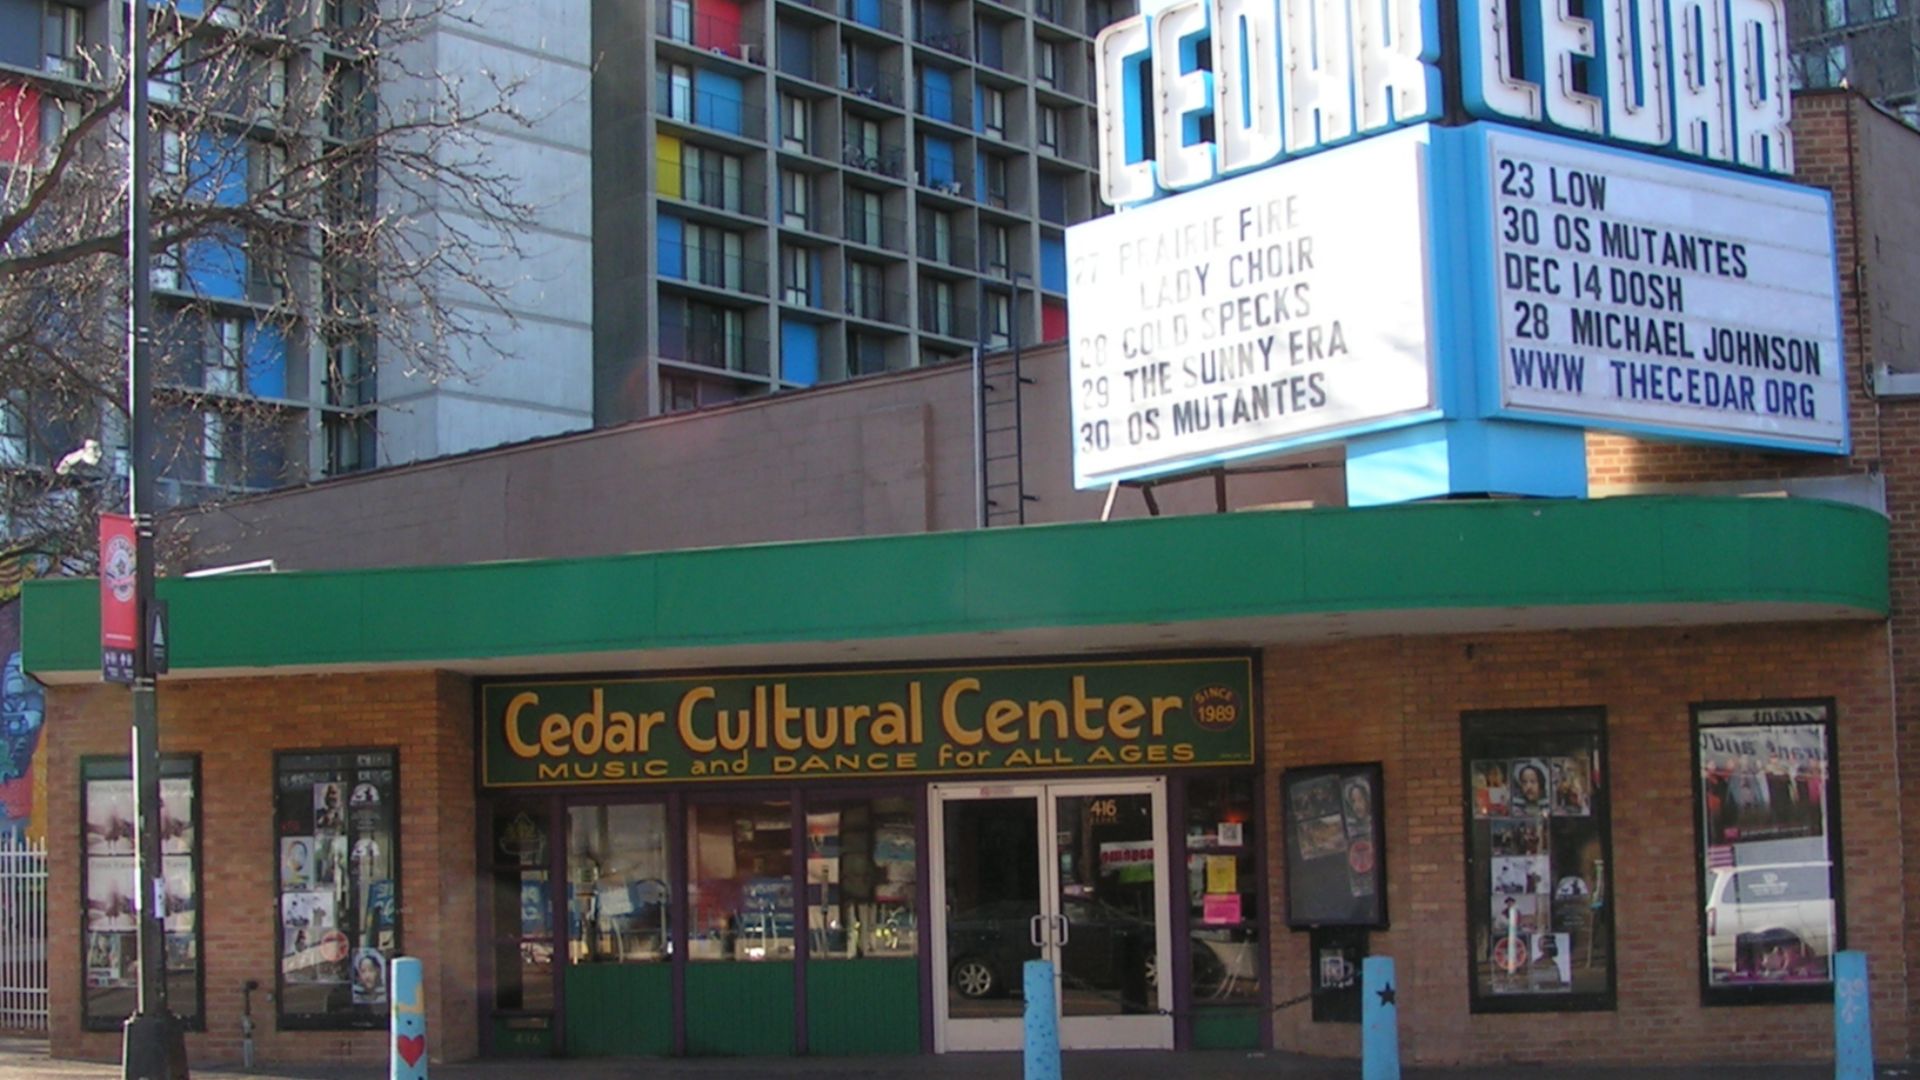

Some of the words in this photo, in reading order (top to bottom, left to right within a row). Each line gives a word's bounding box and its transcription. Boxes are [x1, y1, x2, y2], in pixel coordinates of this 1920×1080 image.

[1095, 0, 1430, 205] CEDAR
[1480, 0, 1796, 177] CEDAR
[1239, 195, 1299, 242] FIRE
[1500, 159, 1535, 199] 23
[1550, 166, 1606, 211] LOW
[1140, 263, 1210, 311] LADY
[1229, 236, 1314, 288] CHOIR
[1503, 206, 1539, 245] 30
[1554, 214, 1591, 253] OS
[1600, 221, 1748, 278] MUTANTES
[1505, 252, 1561, 295] DEC
[1573, 262, 1602, 300] 14
[1610, 268, 1684, 313] DOSH
[1122, 314, 1188, 359] COLD
[1201, 282, 1311, 339] SPECKS
[1515, 301, 1549, 340] 28
[1570, 308, 1694, 359] MICHAEL
[1704, 326, 1820, 376] JOHNSON
[1082, 376, 1109, 411] 29
[1124, 362, 1172, 403] THE
[1183, 336, 1274, 388] SUNNY
[1289, 320, 1349, 366] ERA
[1510, 348, 1585, 393] WWW
[1610, 360, 1755, 411] THECEDAR
[1765, 379, 1816, 419] ORG
[1080, 419, 1110, 452] 30
[1128, 408, 1161, 445] OS
[1173, 372, 1327, 436] MUTANTES
[505, 687, 666, 758] Cedar
[677, 680, 923, 753] Cultural
[941, 674, 1183, 746] Center
[1194, 687, 1233, 703] SINCE
[1199, 705, 1236, 723] 1989
[538, 759, 669, 780] MUSIC
[690, 749, 749, 776] and
[773, 752, 918, 774] DANCE
[939, 743, 992, 767] for
[1004, 747, 1073, 766] ALL
[1087, 743, 1195, 763] AGES
[1090, 800, 1117, 816] 416
